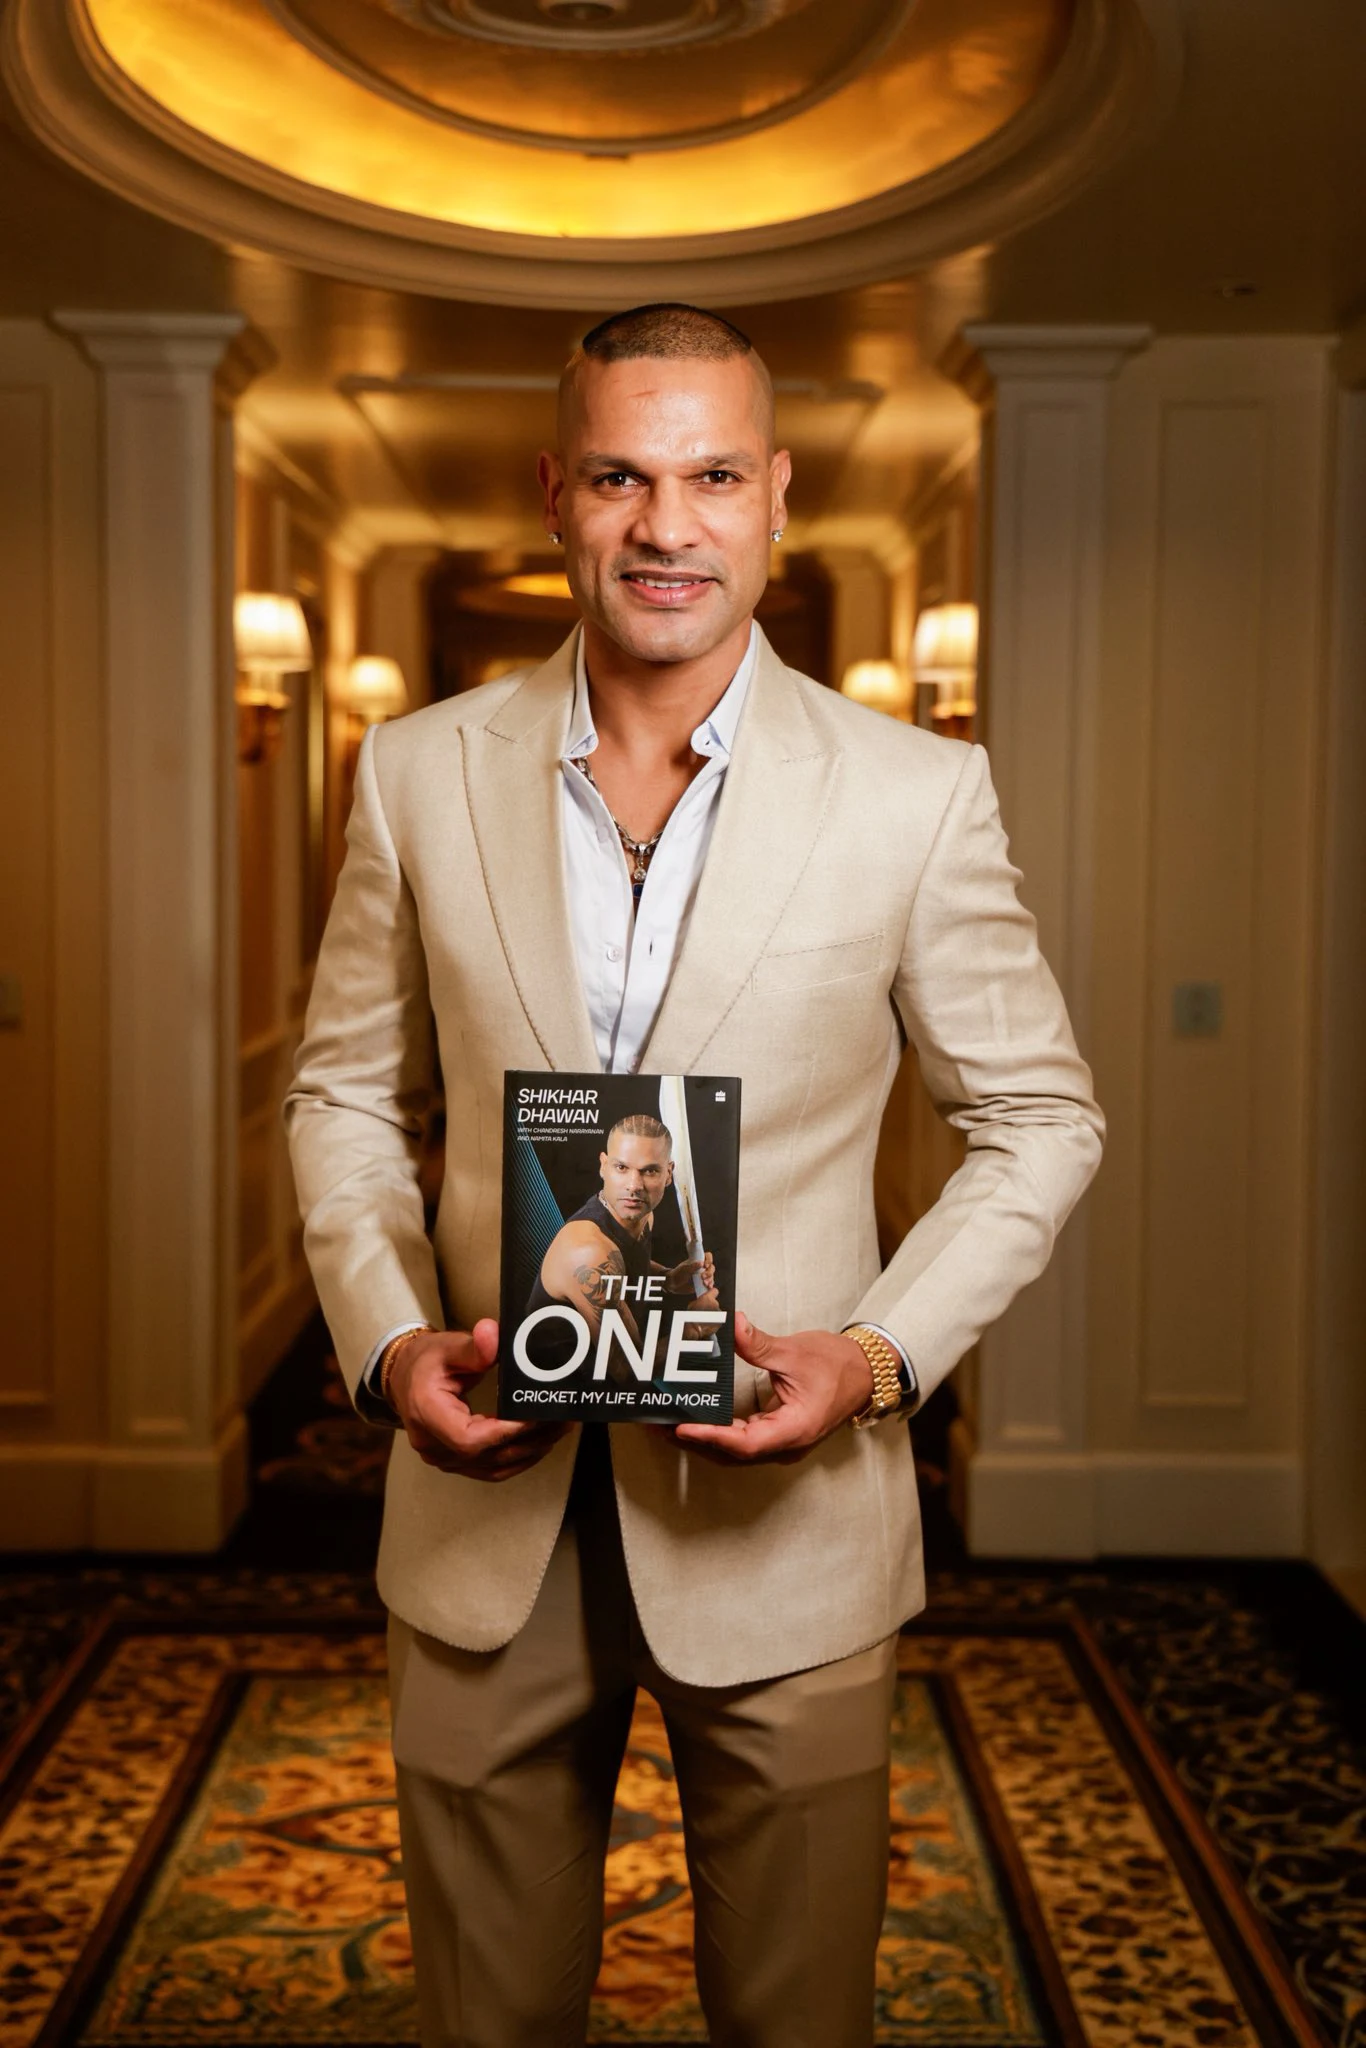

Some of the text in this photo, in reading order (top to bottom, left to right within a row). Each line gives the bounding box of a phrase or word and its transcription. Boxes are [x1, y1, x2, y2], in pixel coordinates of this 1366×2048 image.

[517, 1088, 598, 1105] SHIKHAR
[517, 1108, 600, 1124] DHAWAN
[600, 1275, 666, 1301] THE
[513, 1305, 727, 1383] ONE
[512, 1389, 720, 1407] CRICKET, MY LIFE AND MORE
